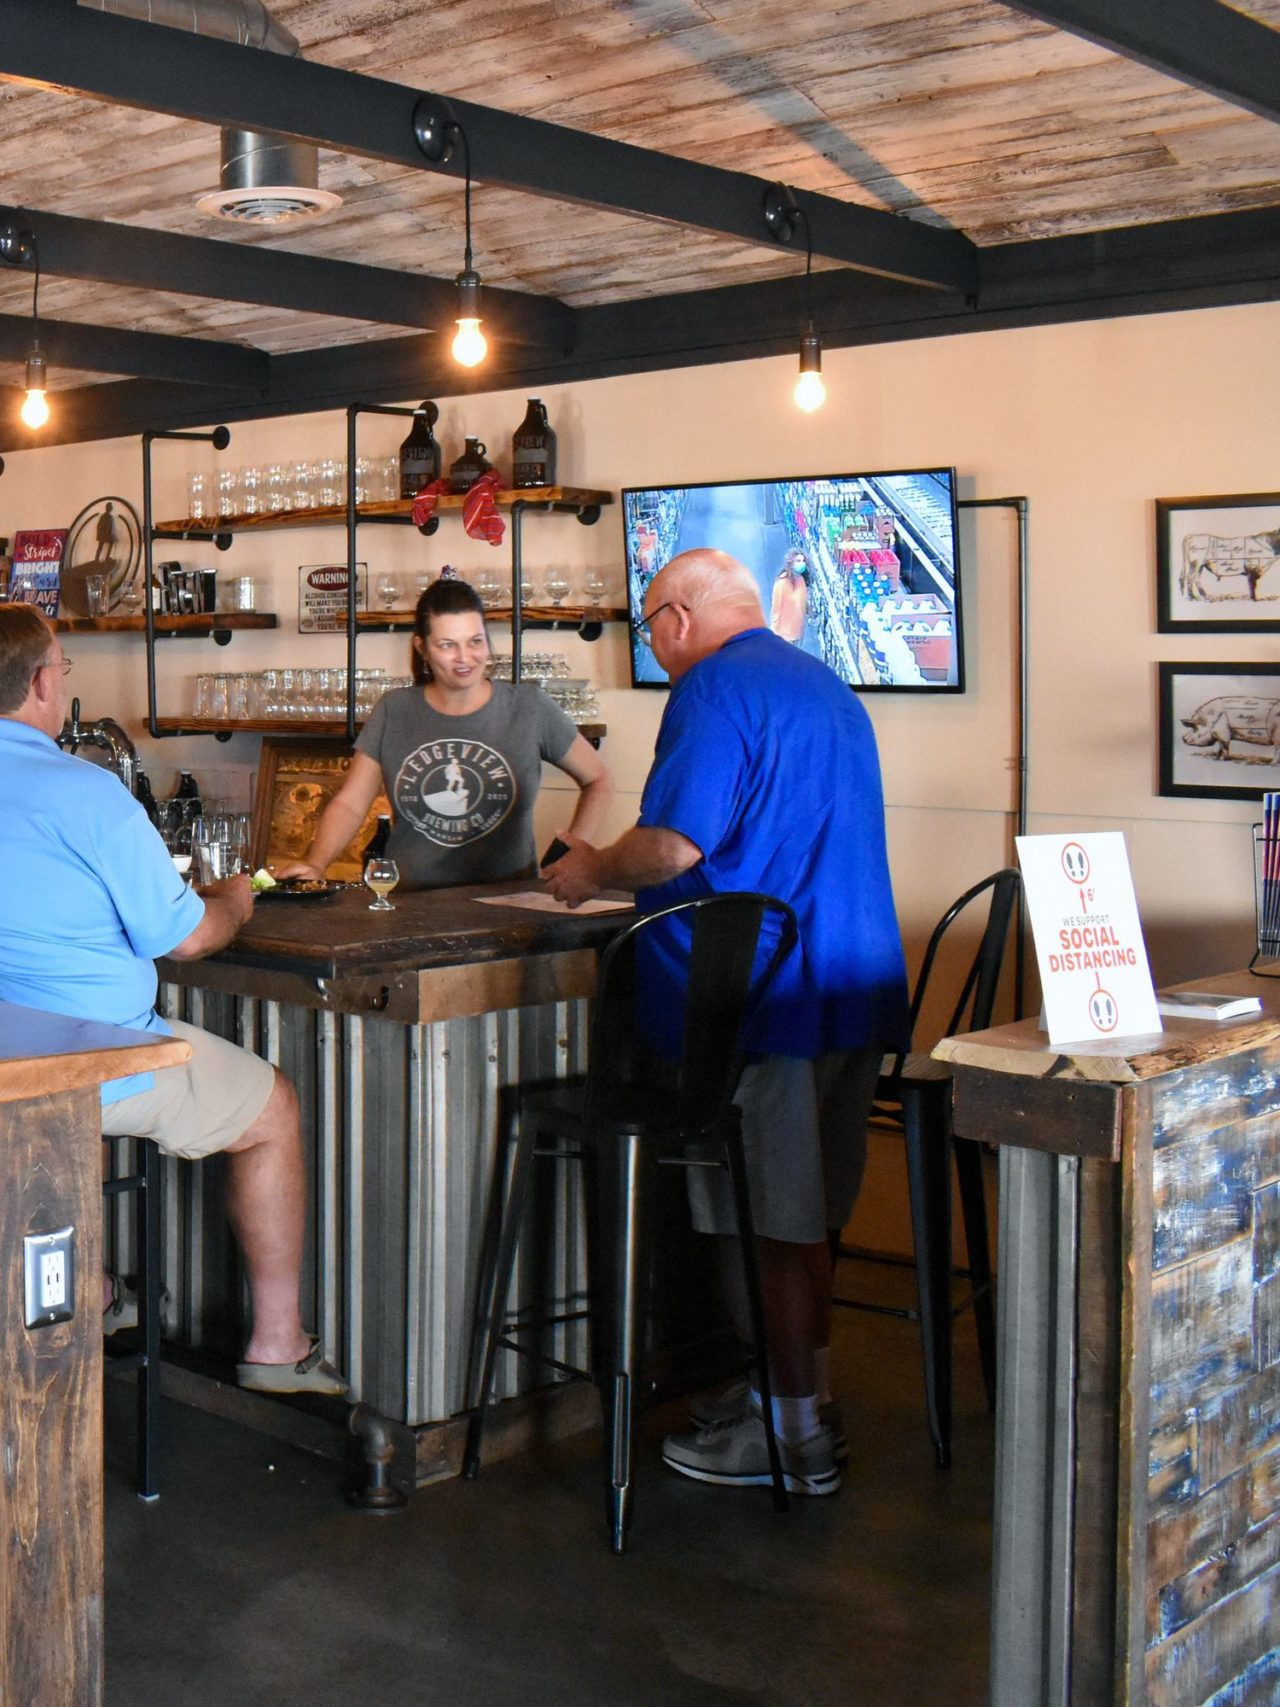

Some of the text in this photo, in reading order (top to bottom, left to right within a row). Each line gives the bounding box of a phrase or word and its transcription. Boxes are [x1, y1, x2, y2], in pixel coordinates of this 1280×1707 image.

[15, 562, 58, 575] BRIGHT
[402, 743, 508, 783] LEDGEVIEW
[1063, 914, 1109, 926] WE SUPPORT
[1059, 926, 1120, 950] SOCIAL
[1048, 947, 1137, 973] DISTANCING
